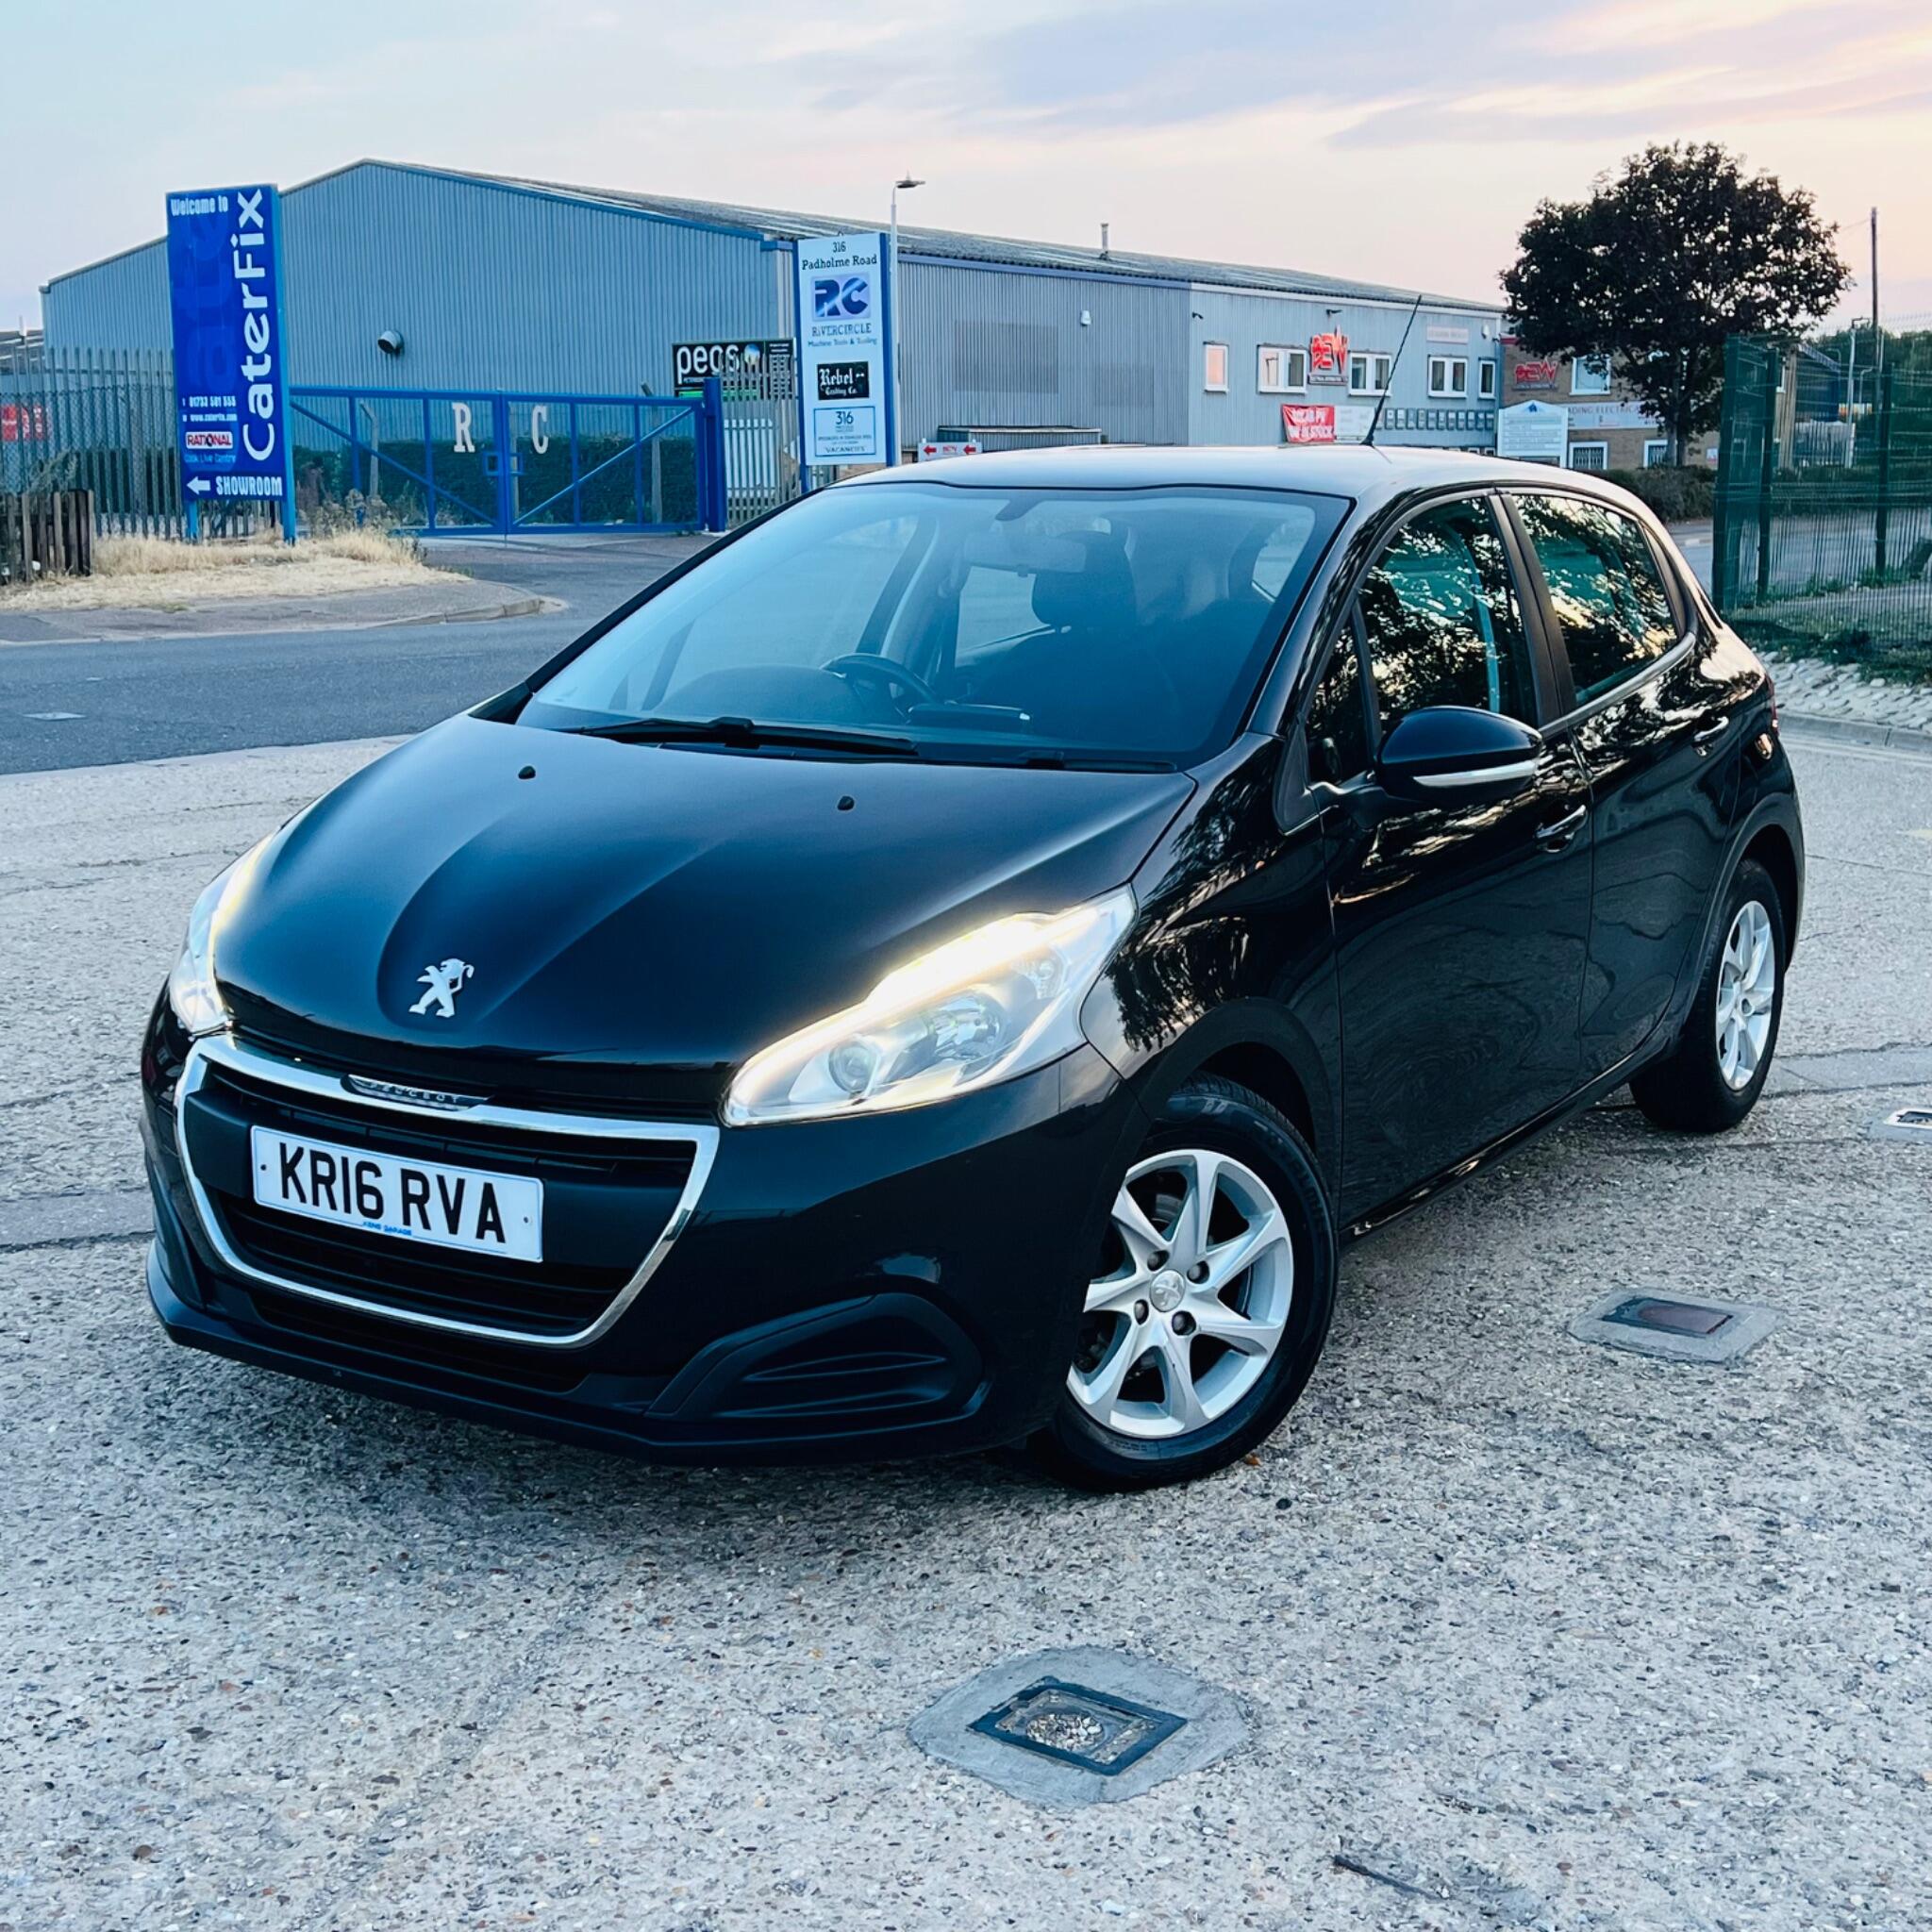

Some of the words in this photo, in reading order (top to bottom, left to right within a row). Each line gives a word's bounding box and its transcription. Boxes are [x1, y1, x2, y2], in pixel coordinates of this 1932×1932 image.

[171, 197, 215, 216] Welcome
[218, 194, 228, 212] to
[832, 242, 846, 253] 316
[802, 257, 850, 270] Padholme
[852, 254, 877, 265] Road
[230, 189, 275, 460] CaterFix
[819, 368, 854, 389] Rebel
[452, 402, 475, 453] R
[532, 405, 549, 454] C
[836, 411, 854, 425] 316
[187, 433, 232, 447] RATIONAL
[215, 475, 283, 496] SHOWROOM
[279, 1141, 384, 1220] KR16
[400, 1168, 506, 1243] RVA
